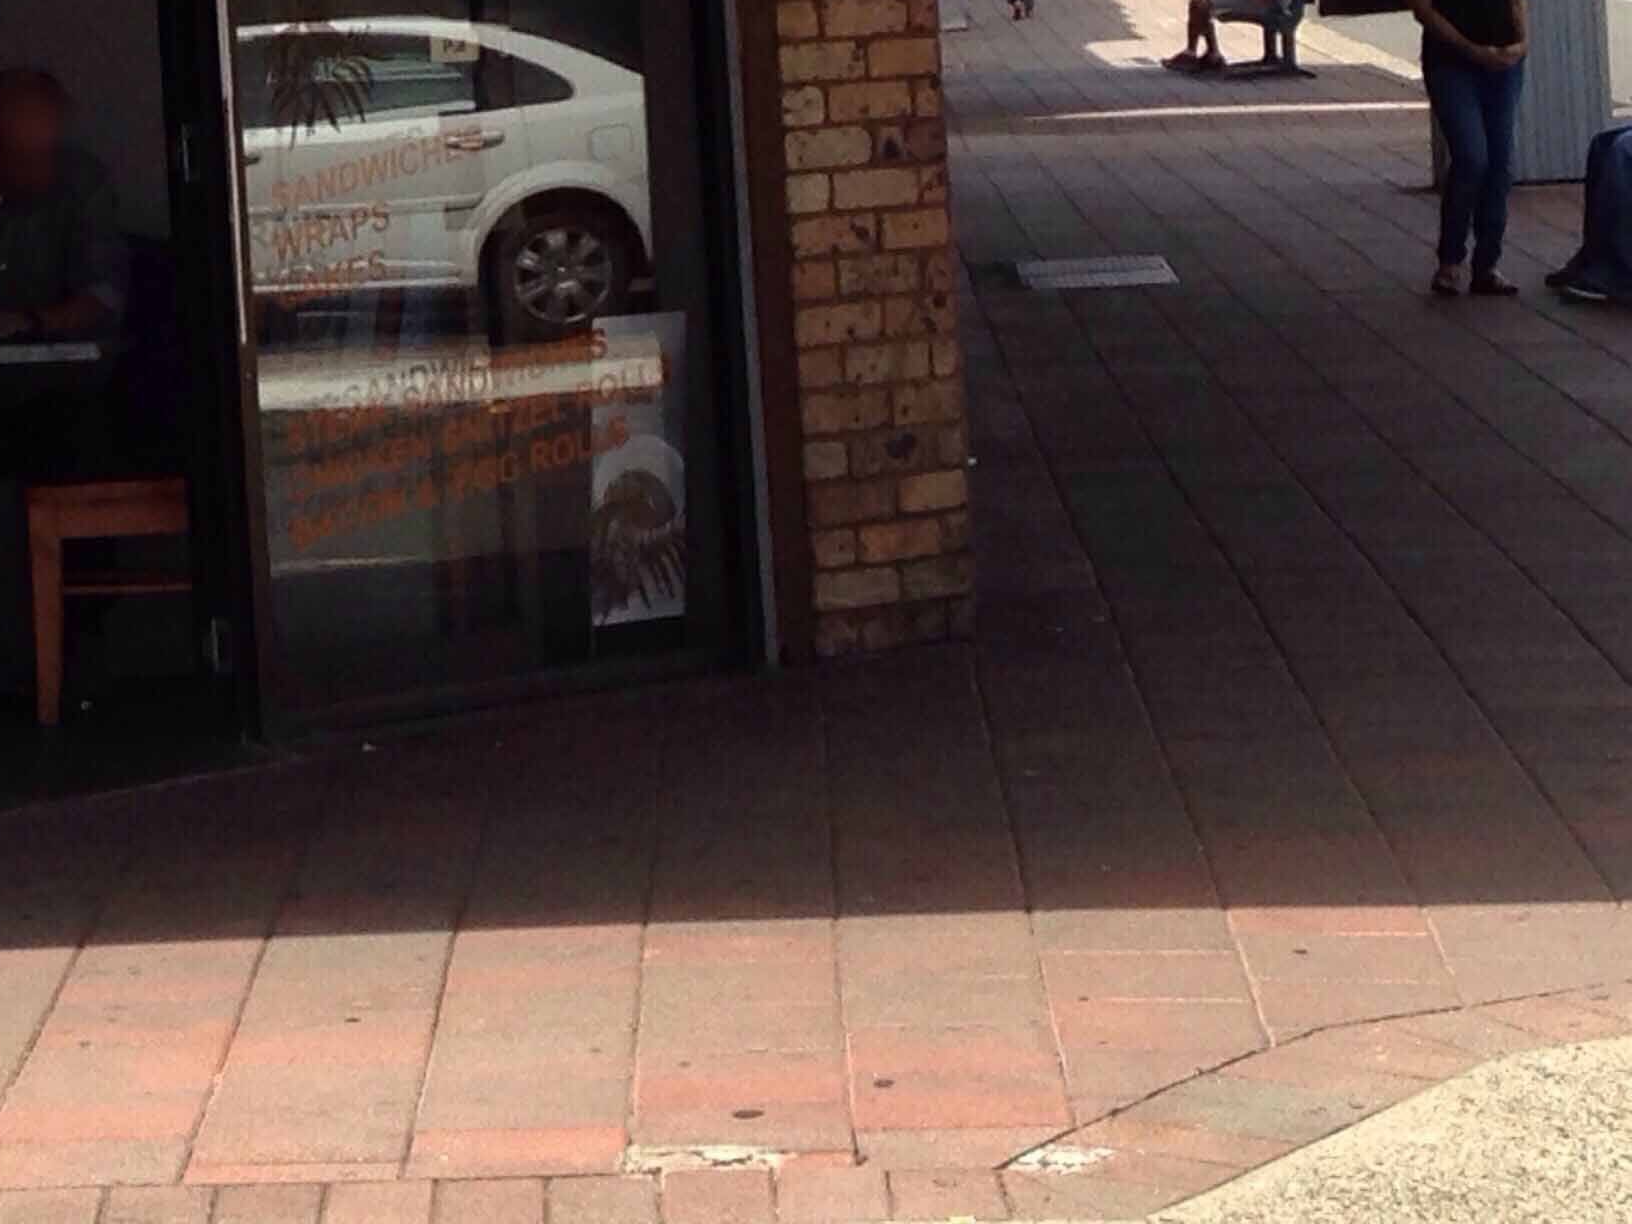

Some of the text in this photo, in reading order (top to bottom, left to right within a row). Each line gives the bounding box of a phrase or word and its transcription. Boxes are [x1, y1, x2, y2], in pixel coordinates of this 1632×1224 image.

[270, 126, 483, 206] SANDWICHES
[272, 202, 392, 261] WRAPS
[529, 414, 631, 473] ROLLS
